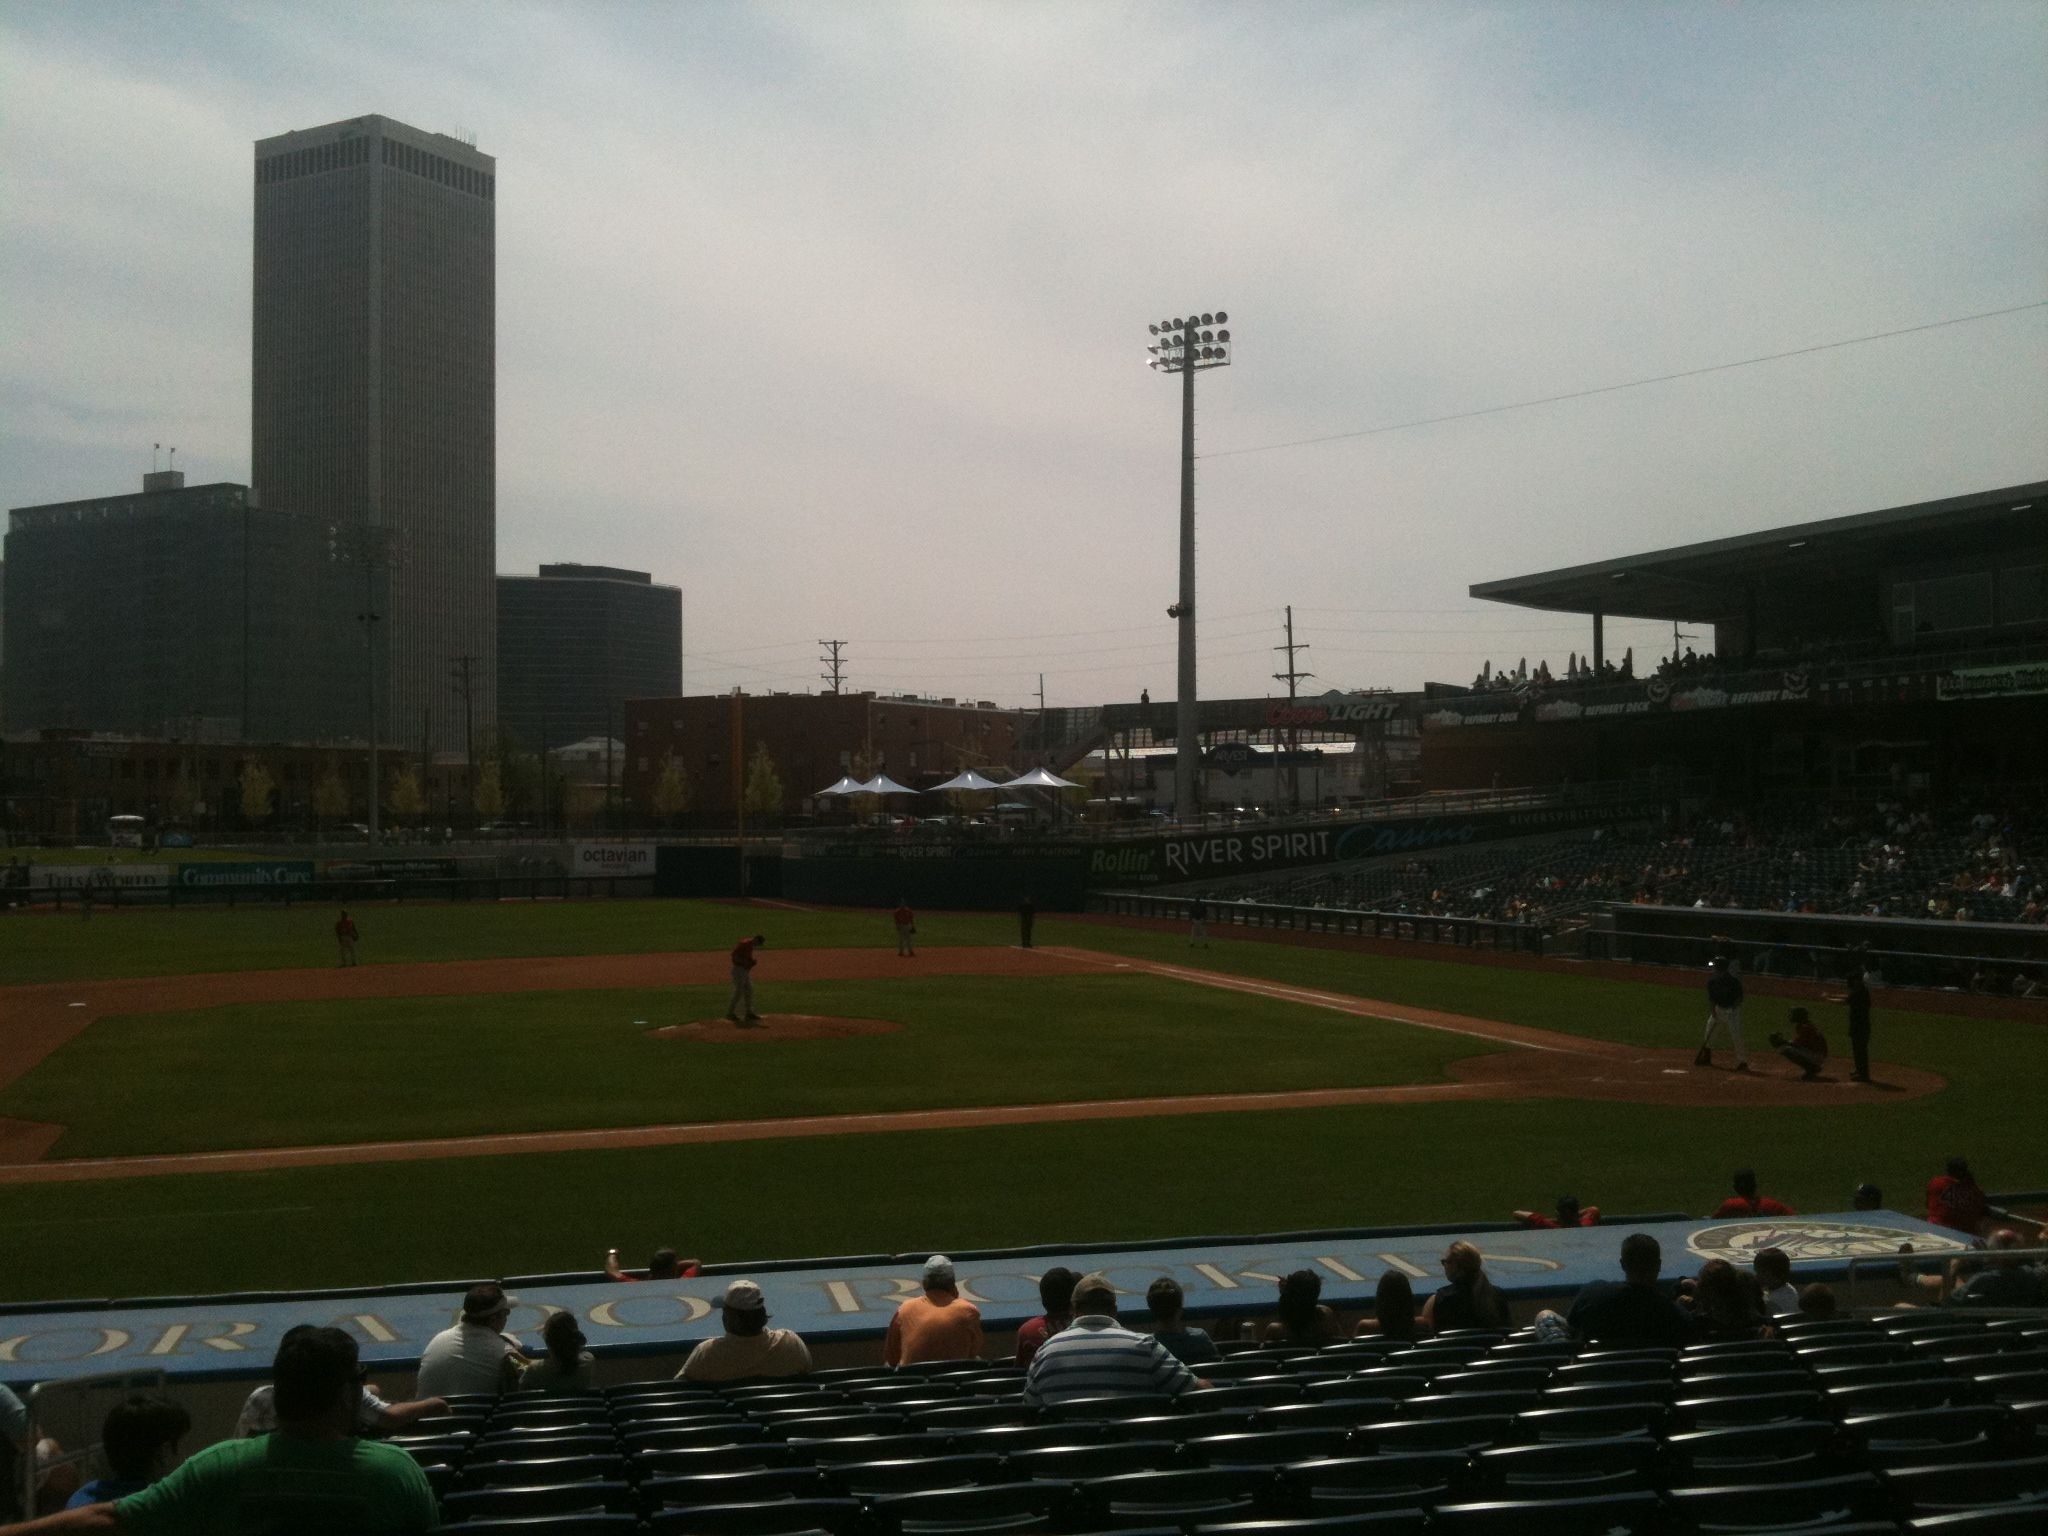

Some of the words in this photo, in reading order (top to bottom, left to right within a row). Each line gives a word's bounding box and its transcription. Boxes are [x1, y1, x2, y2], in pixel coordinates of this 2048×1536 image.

[1328, 703, 1399, 722] LIGHT
[1625, 701, 1649, 712] DECK
[1499, 711, 1519, 722] DECK
[583, 848, 649, 864] octavian
[899, 846, 925, 860] RIVER
[925, 846, 953, 858] SPIRIT
[1165, 838, 1244, 876] RIVER
[1251, 831, 1330, 862] SPIRIT
[1335, 823, 1473, 860] Casino
[1090, 847, 1156, 873] Rollin'
